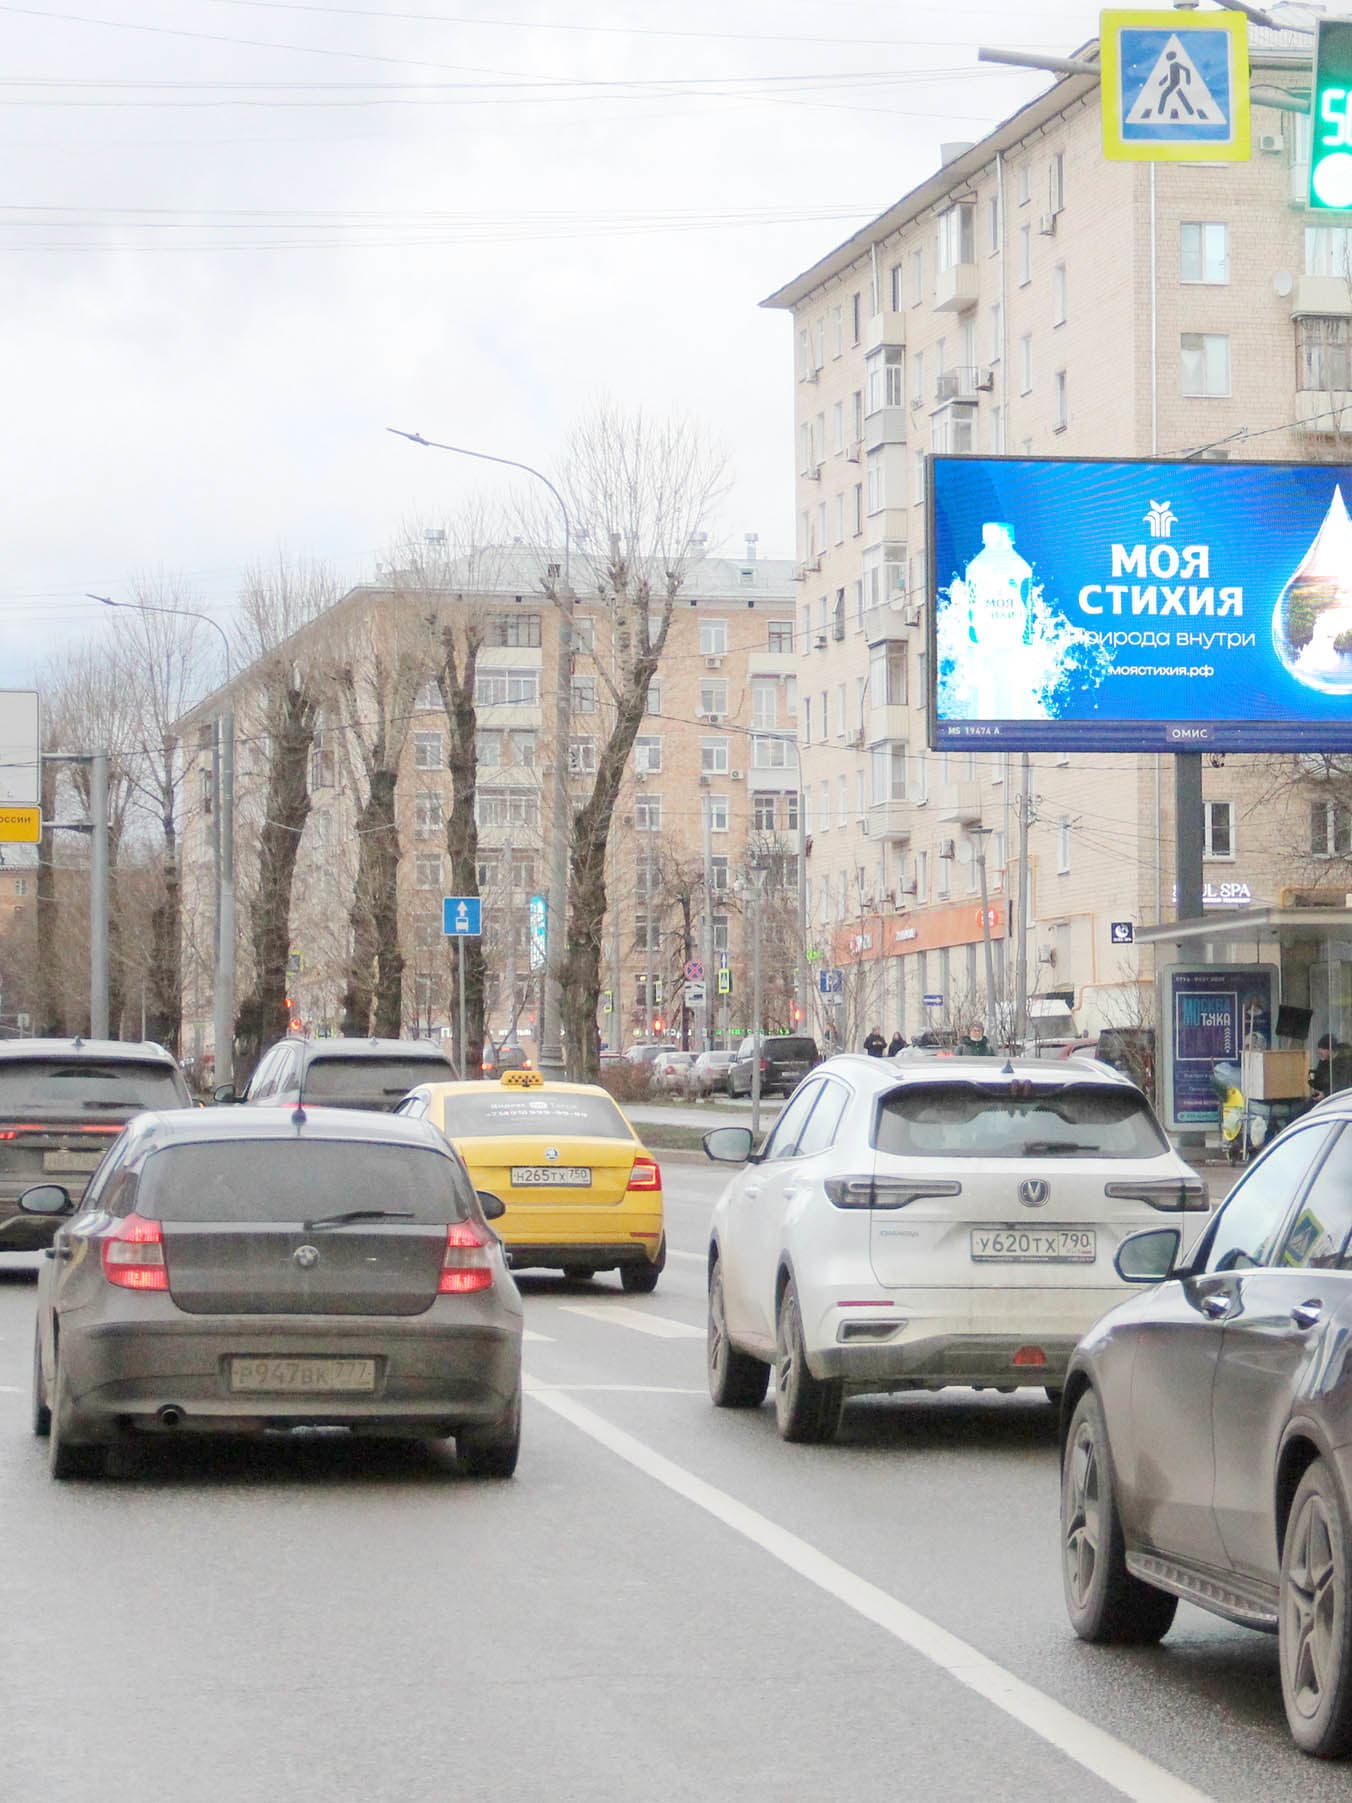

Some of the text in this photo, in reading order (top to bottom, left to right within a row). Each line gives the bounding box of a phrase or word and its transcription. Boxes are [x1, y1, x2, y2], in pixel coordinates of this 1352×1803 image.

[1111, 543, 1210, 579] МОЯ
[1078, 584, 1244, 617] СТИХИЯ
[1078, 631, 1255, 650] рирода внутри
[1109, 665, 1215, 678] моястихия.рф
[1172, 729, 1208, 738] ОМИС
[1220, 883, 1251, 897] SPA
[516, 1168, 587, 1182] Н265ТХ 750
[980, 1233, 1089, 1252] У620ТХ 790
[240, 1360, 369, 1385] Р947ВК 777
